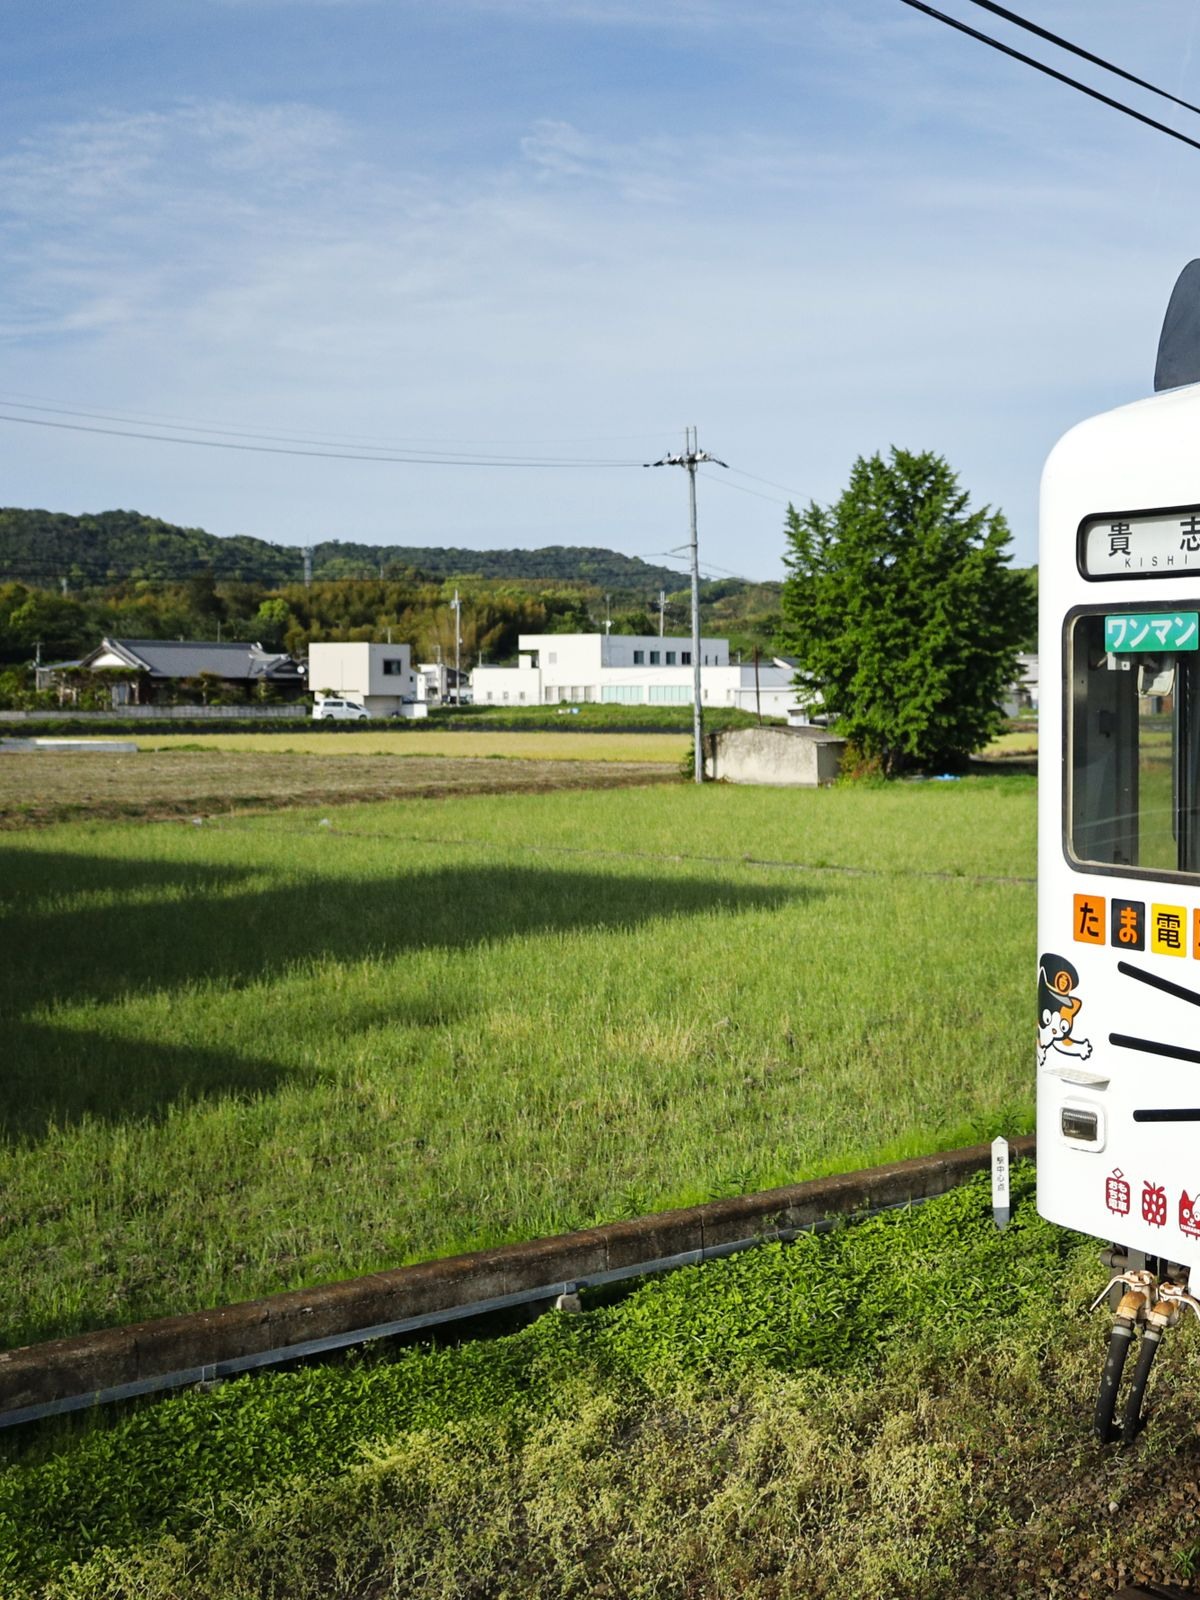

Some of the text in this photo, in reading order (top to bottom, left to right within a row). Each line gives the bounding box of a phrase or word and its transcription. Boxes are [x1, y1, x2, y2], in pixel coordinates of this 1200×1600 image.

[1124, 554, 1188, 568] KISHI
[1107, 616, 1197, 648] ワンマン
